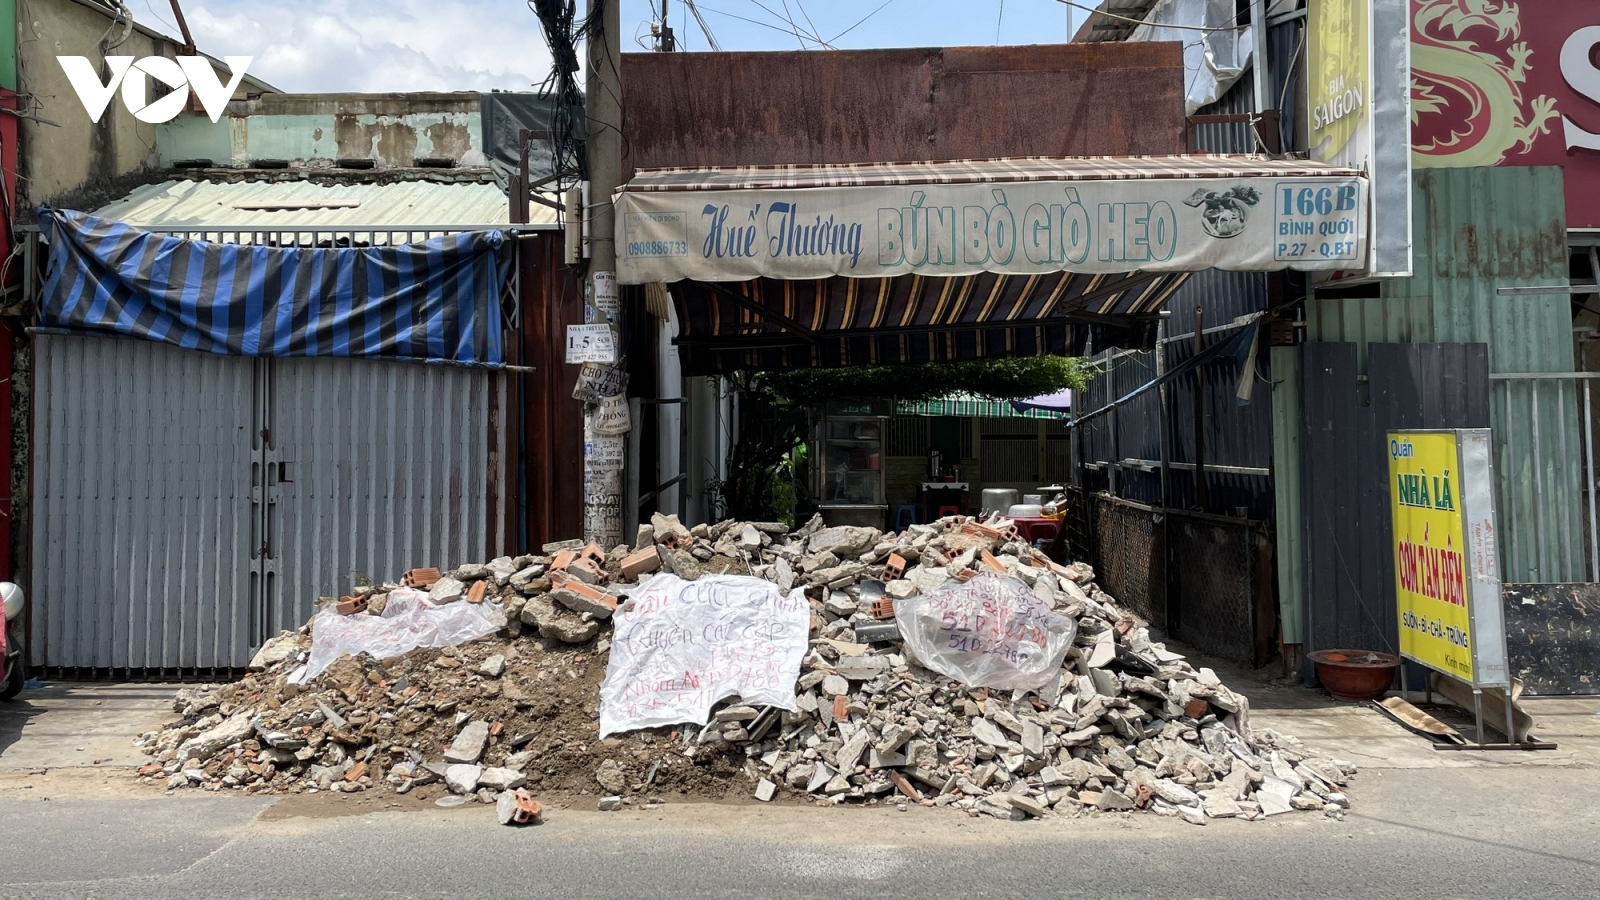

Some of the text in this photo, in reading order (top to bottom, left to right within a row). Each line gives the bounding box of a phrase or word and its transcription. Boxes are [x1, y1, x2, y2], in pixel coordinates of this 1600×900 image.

[1329, 76, 1345, 96] BIA
[1313, 82, 1363, 131] SAIGON
[1281, 185, 1356, 216] 166B
[702, 202, 864, 268] Huế Thương
[877, 187, 1178, 266] BÚN BÒ GIÒ HEO
[1279, 216, 1354, 237] BÌNH QUỚI
[628, 240, 687, 256] 0908886733
[1278, 243, 1307, 257] P.27
[1320, 241, 1354, 257] Q.BT
[569, 336, 574, 349] 1
[582, 335, 590, 349] 5
[582, 366, 602, 379] CHO
[1391, 439, 1413, 458] Quán
[1397, 467, 1432, 509] NHÀ
[1440, 534, 1465, 608] ĐÊM
[1403, 610, 1418, 630] SƯỜN
[1421, 614, 1427, 634] BÌ
[1430, 618, 1443, 639] CHẢ
[1446, 624, 1468, 648] TRỨNG
